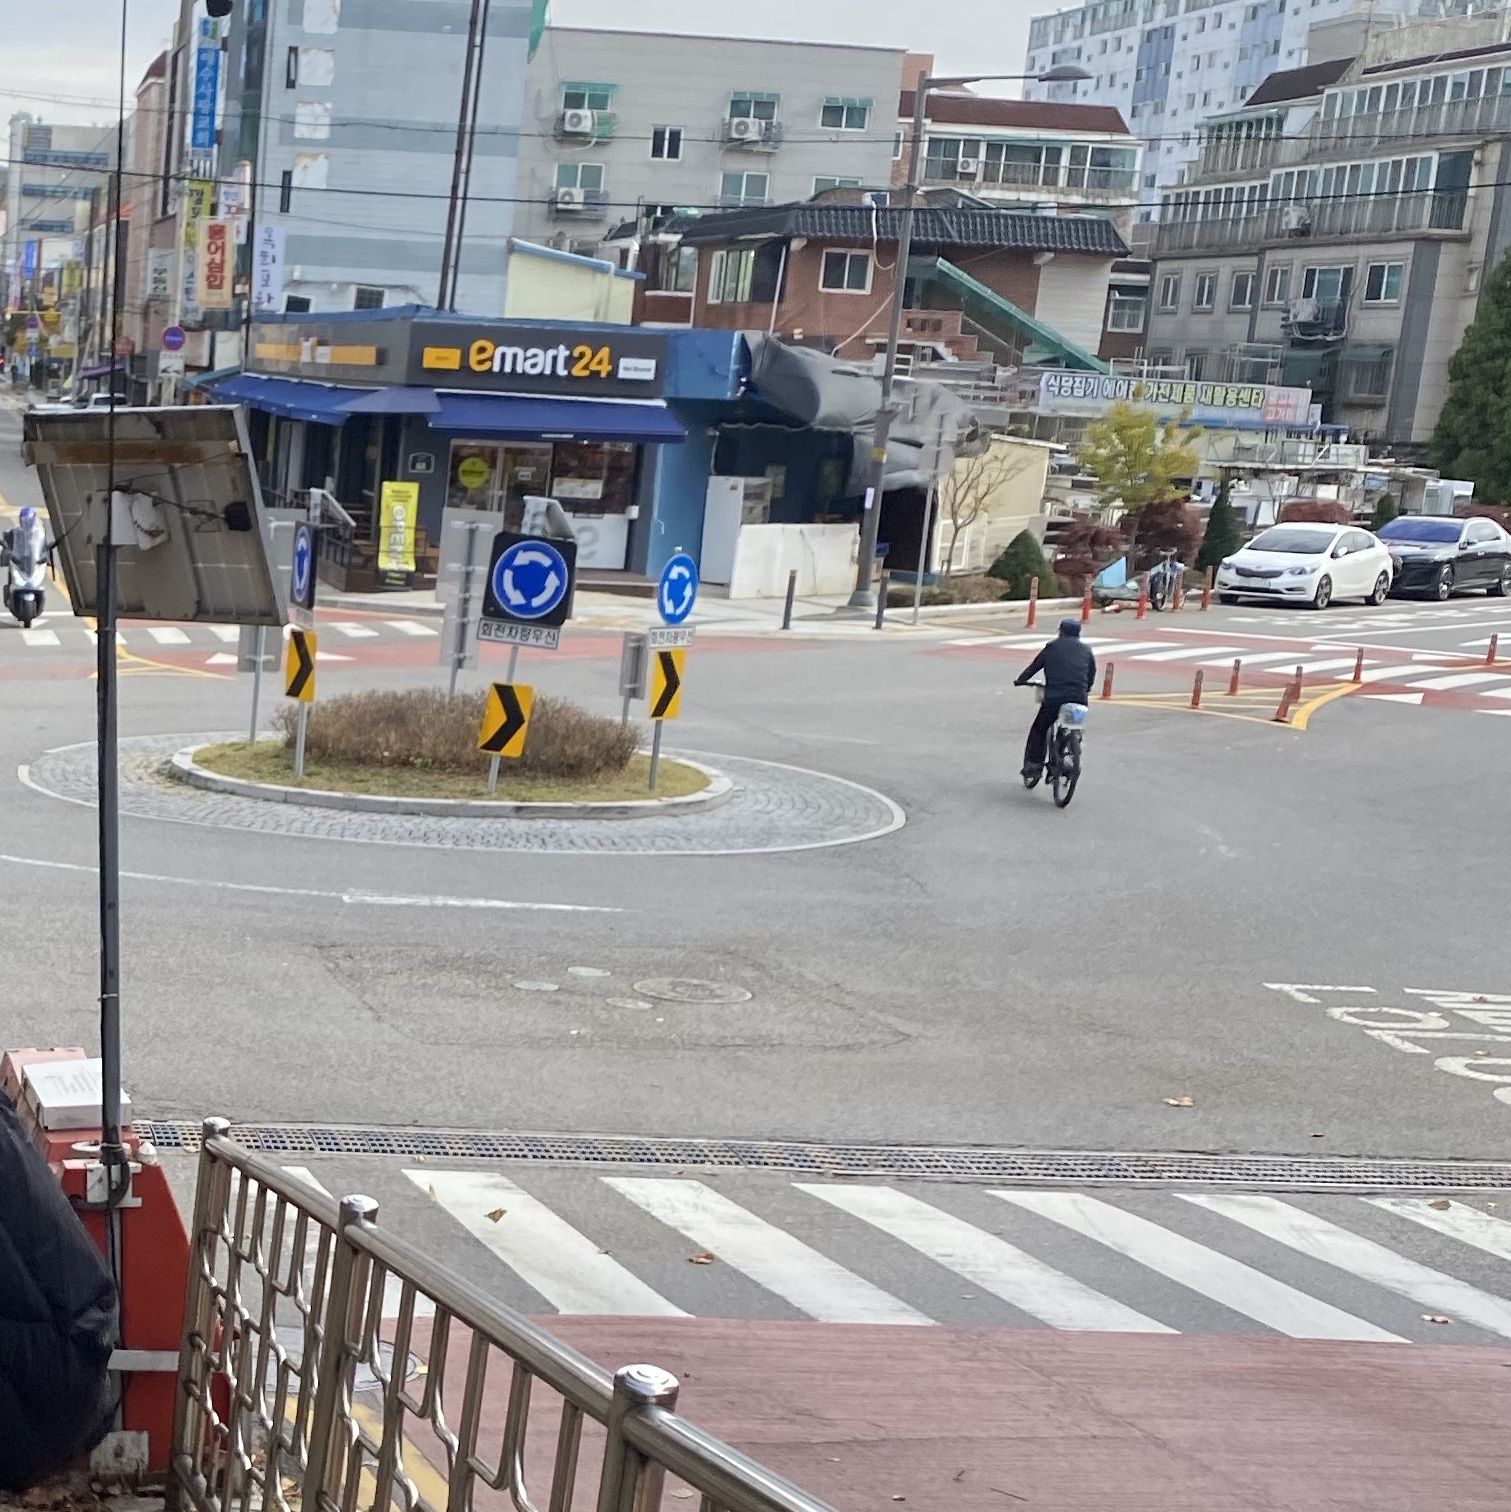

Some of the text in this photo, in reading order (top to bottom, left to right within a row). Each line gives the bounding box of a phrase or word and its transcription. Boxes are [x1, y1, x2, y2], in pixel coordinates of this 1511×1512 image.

[469, 338, 612, 378] emart24
[1048, 375, 1099, 398] 식당집기
[1145, 381, 1196, 404] 가전제품
[481, 622, 557, 646] 회전차량우선
